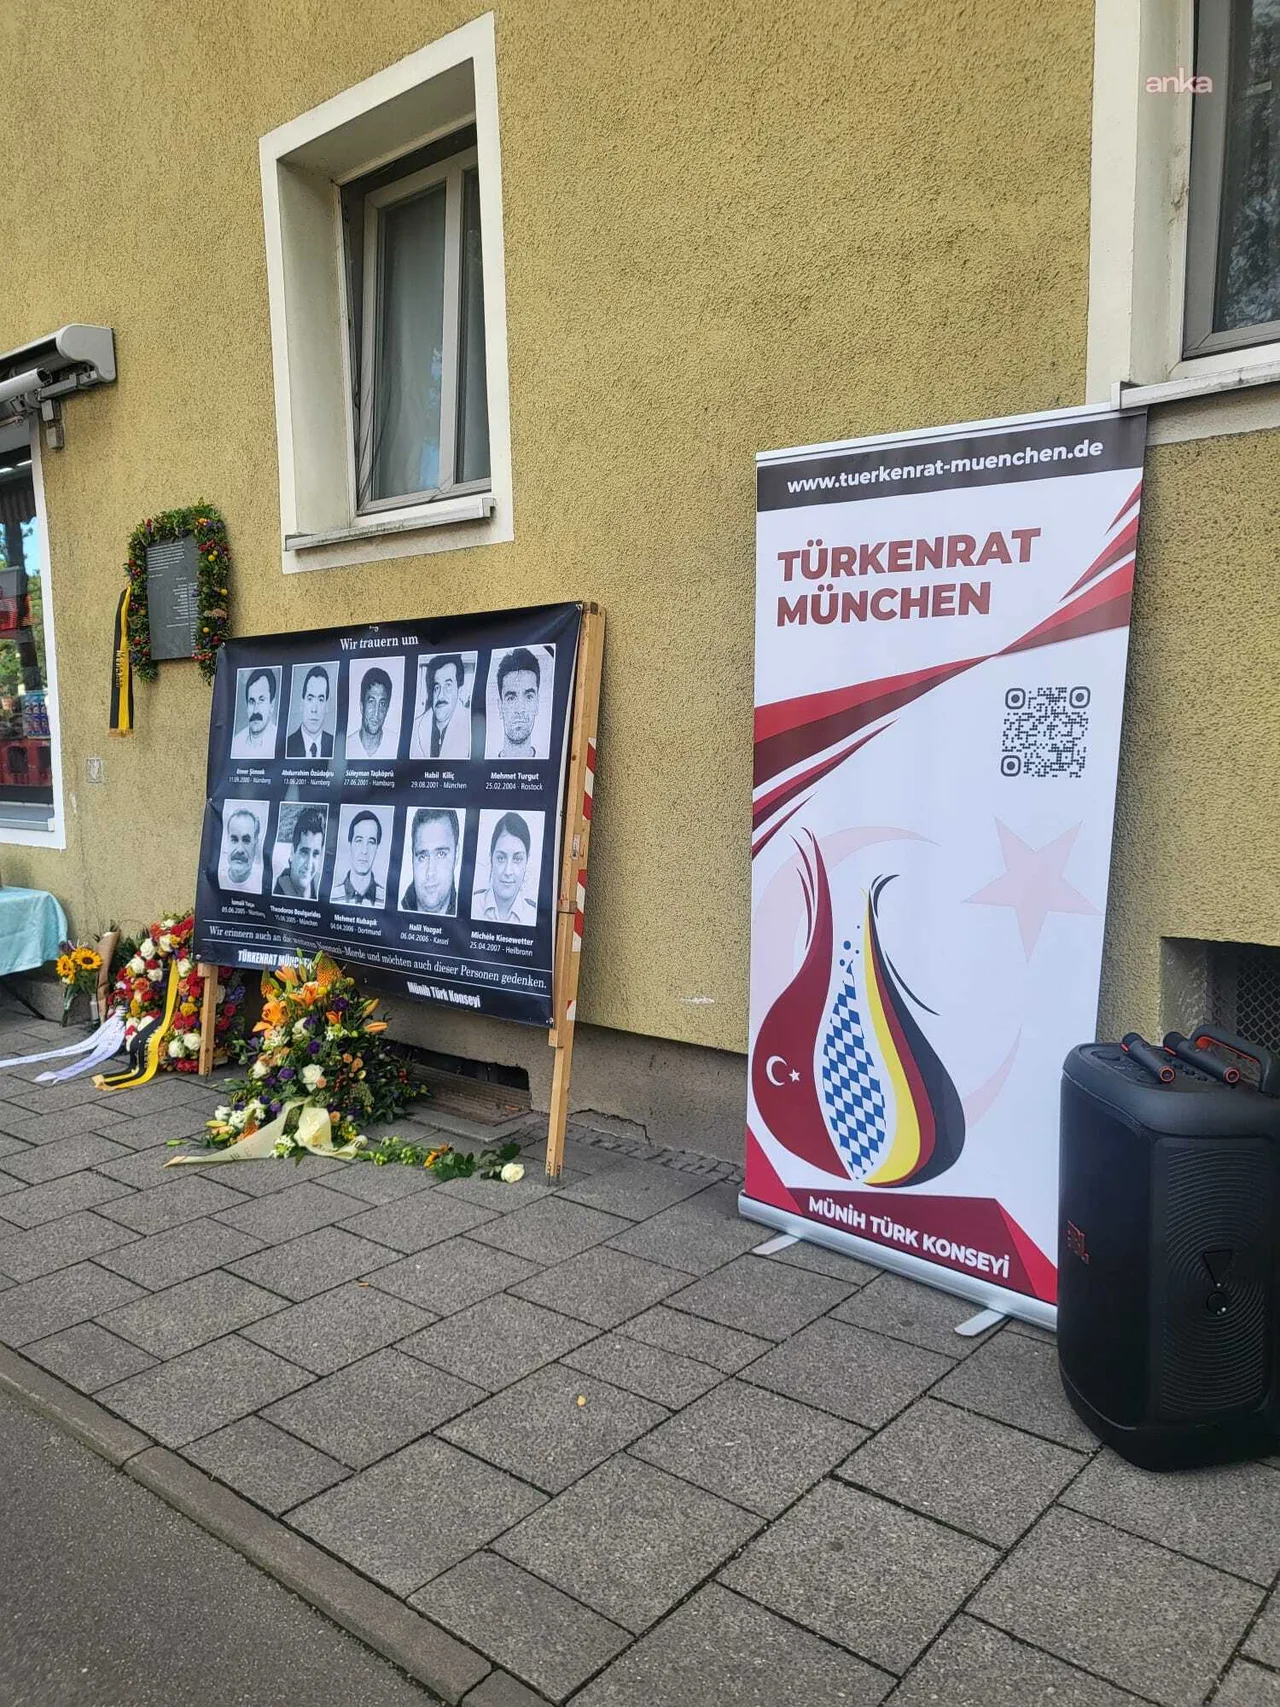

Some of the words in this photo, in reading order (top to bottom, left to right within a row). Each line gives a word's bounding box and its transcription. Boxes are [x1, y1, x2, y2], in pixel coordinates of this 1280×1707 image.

[787, 440, 1104, 493] www.tuerkenrat-muenchen.de
[778, 527, 1041, 581] TÜRKENRAT
[777, 582, 991, 627] MÜNCHEN
[340, 638, 358, 651] Wir
[360, 637, 399, 649] trauern
[401, 635, 419, 646] um
[490, 772, 516, 780] Mehmet
[517, 772, 539, 781] Turgut
[411, 781, 439, 789] 29.08.2001
[443, 780, 467, 790] München
[485, 782, 516, 790] 25.02.2004
[520, 782, 543, 790] Rostock
[357, 927, 382, 936] Dortmund
[409, 923, 422, 932] Halil
[422, 925, 442, 934] Yozgat
[496, 934, 534, 946] Kiesewetter
[209, 925, 223, 936] Wir
[224, 927, 254, 939] erinnern
[255, 931, 272, 941] auch
[272, 934, 281, 942] an
[367, 951, 381, 962] und
[382, 954, 412, 968] möchten
[413, 959, 432, 971] auch
[434, 961, 459, 975] dieser
[460, 964, 499, 981] Personen
[501, 972, 547, 989] gedenken.
[238, 948, 279, 966] TÜRKENRAT
[469, 941, 501, 952] 25.04.2007
[505, 946, 533, 957] Heilbronn
[449, 989, 481, 1008] Konseyi
[809, 1195, 866, 1230] MÜNİH
[870, 1215, 919, 1248] TÜRK
[923, 1234, 1010, 1279] KONSEYİ
